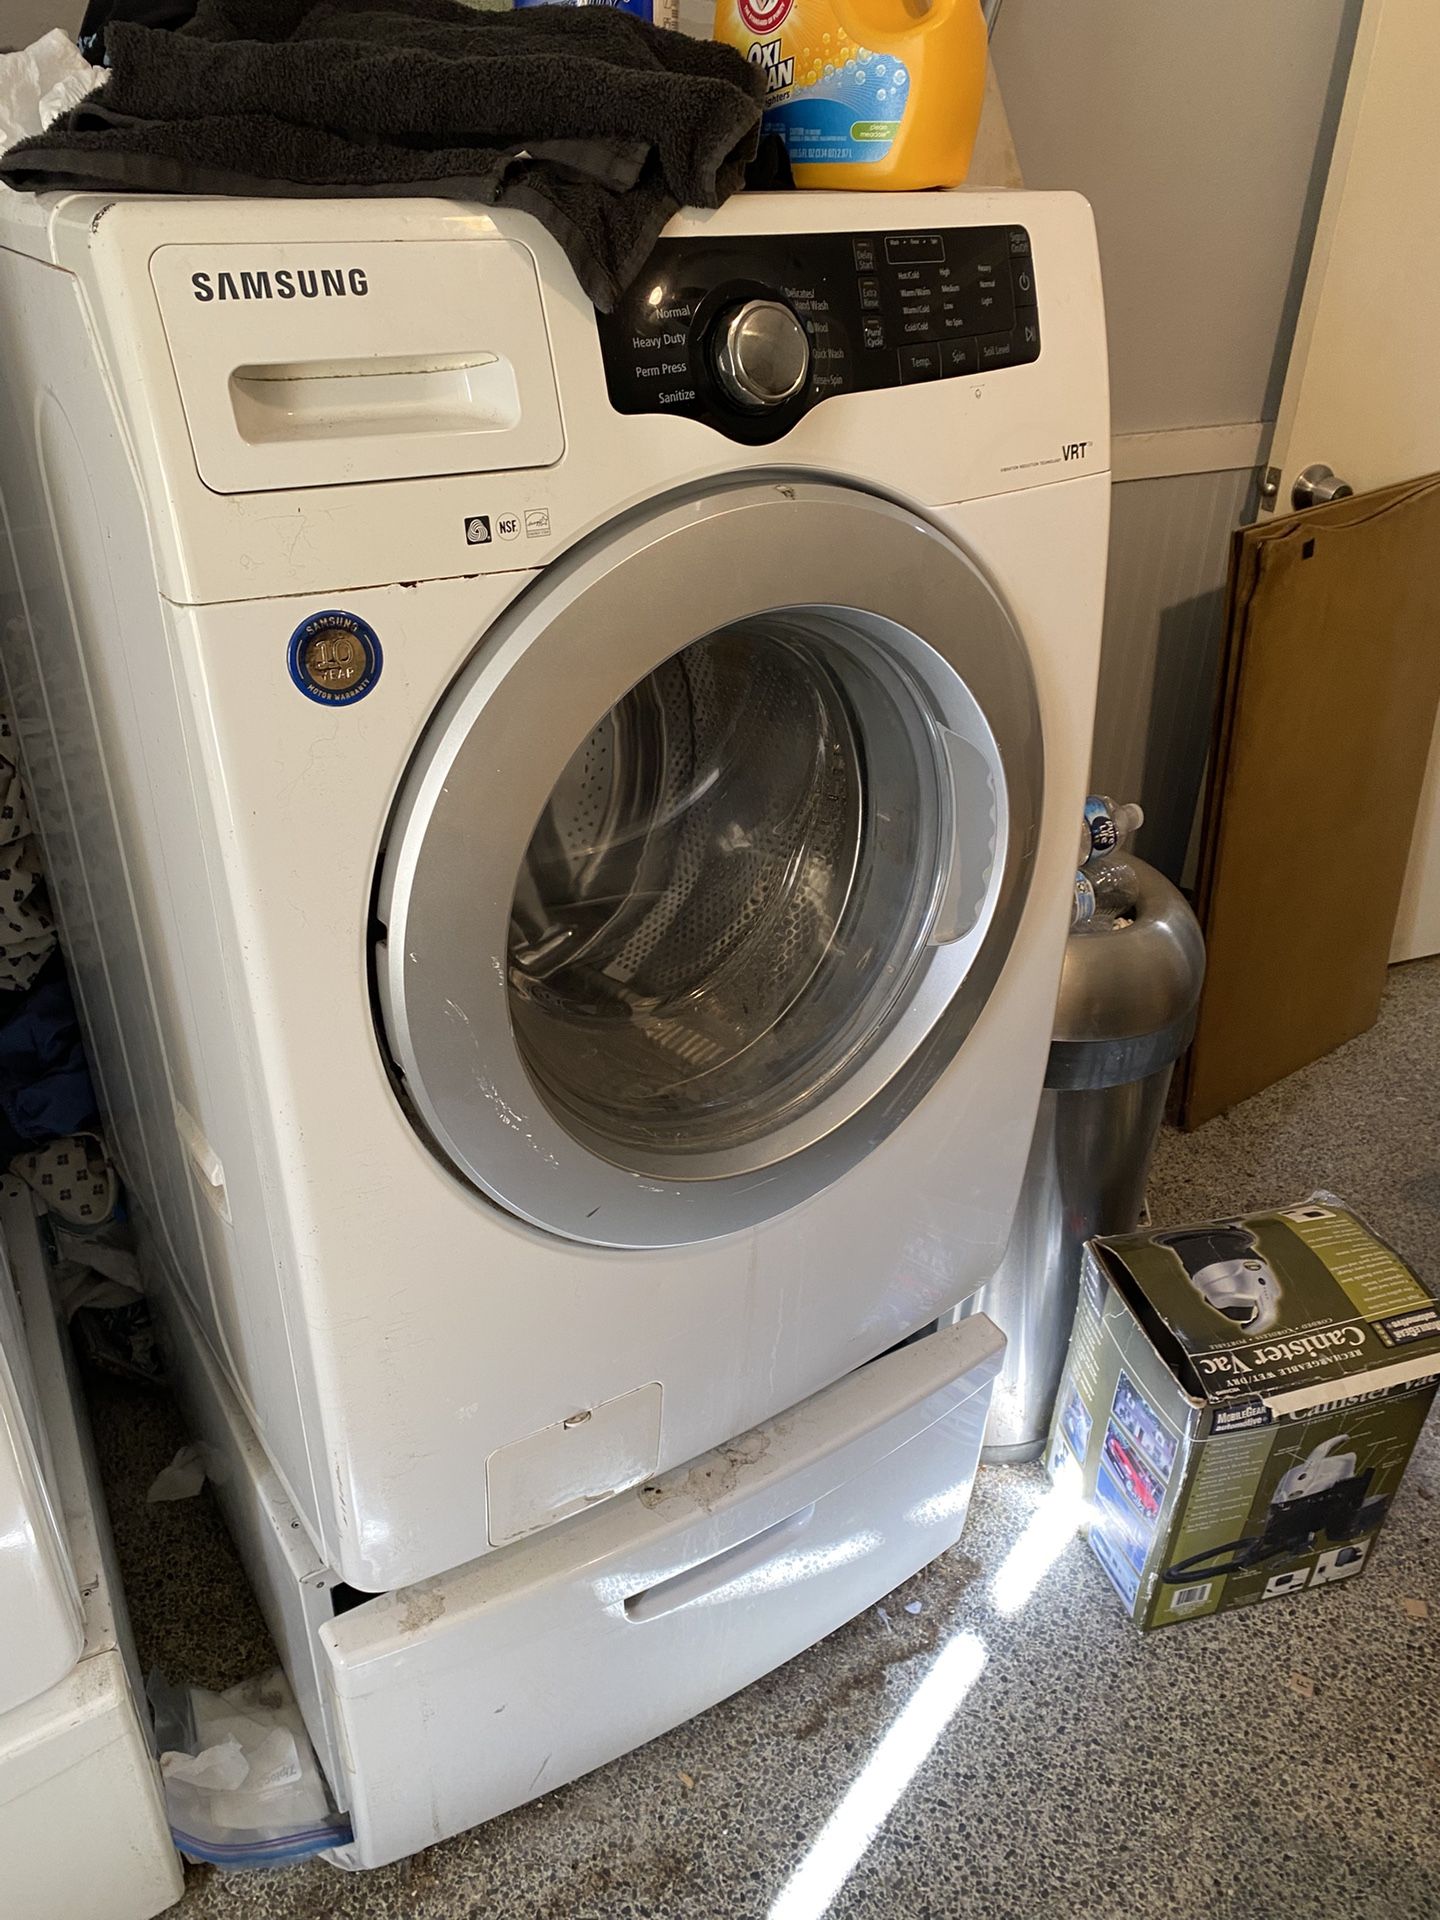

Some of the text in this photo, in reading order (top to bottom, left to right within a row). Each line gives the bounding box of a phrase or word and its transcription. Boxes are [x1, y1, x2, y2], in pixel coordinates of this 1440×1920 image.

[191, 268, 369, 302] SAMSUNG
[656, 304, 691, 320] Normal
[632, 333, 686, 349] Heavy Duty
[635, 363, 687, 379] Perm Press
[658, 389, 696, 404] Sanitize
[1062, 442, 1087, 461] VRT
[499, 520, 517, 534] NSF
[305, 616, 359, 635] SAMSUNG
[315, 639, 354, 670] 10
[307, 679, 370, 701] MOTOR WARRANTY
[1253, 1326, 1366, 1365] Canister
[1199, 1354, 1254, 1375] Vac
[1226, 1349, 1363, 1387] RECHARGEABLE WET/DRY
